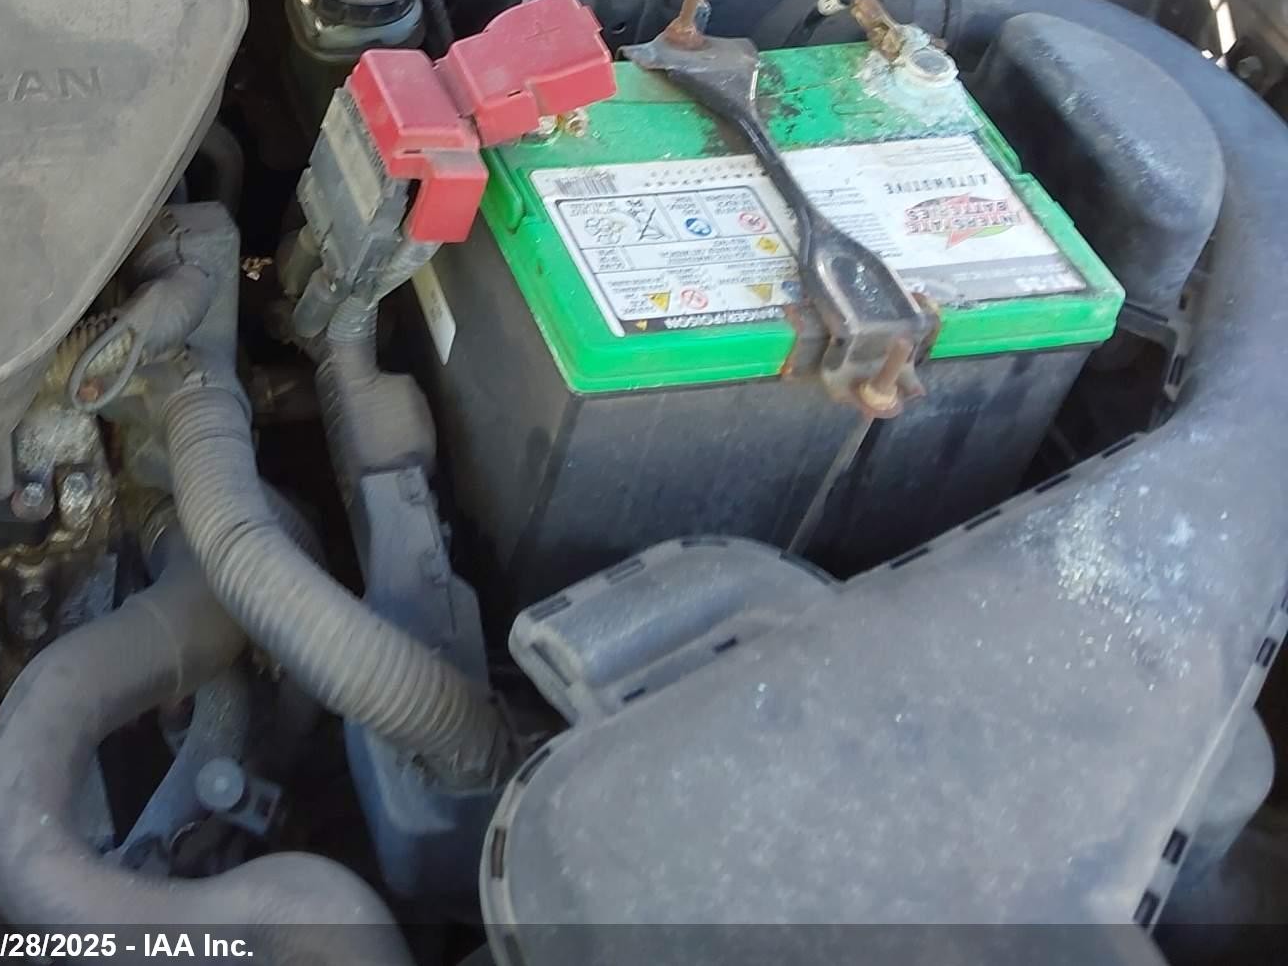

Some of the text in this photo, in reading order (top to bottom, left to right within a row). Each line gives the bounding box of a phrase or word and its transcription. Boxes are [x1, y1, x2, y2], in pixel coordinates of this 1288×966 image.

[884, 173, 989, 195] AUTOMOTIVE
[906, 199, 1009, 222] BATTERIES
[905, 211, 1023, 234] INTERSTATE
